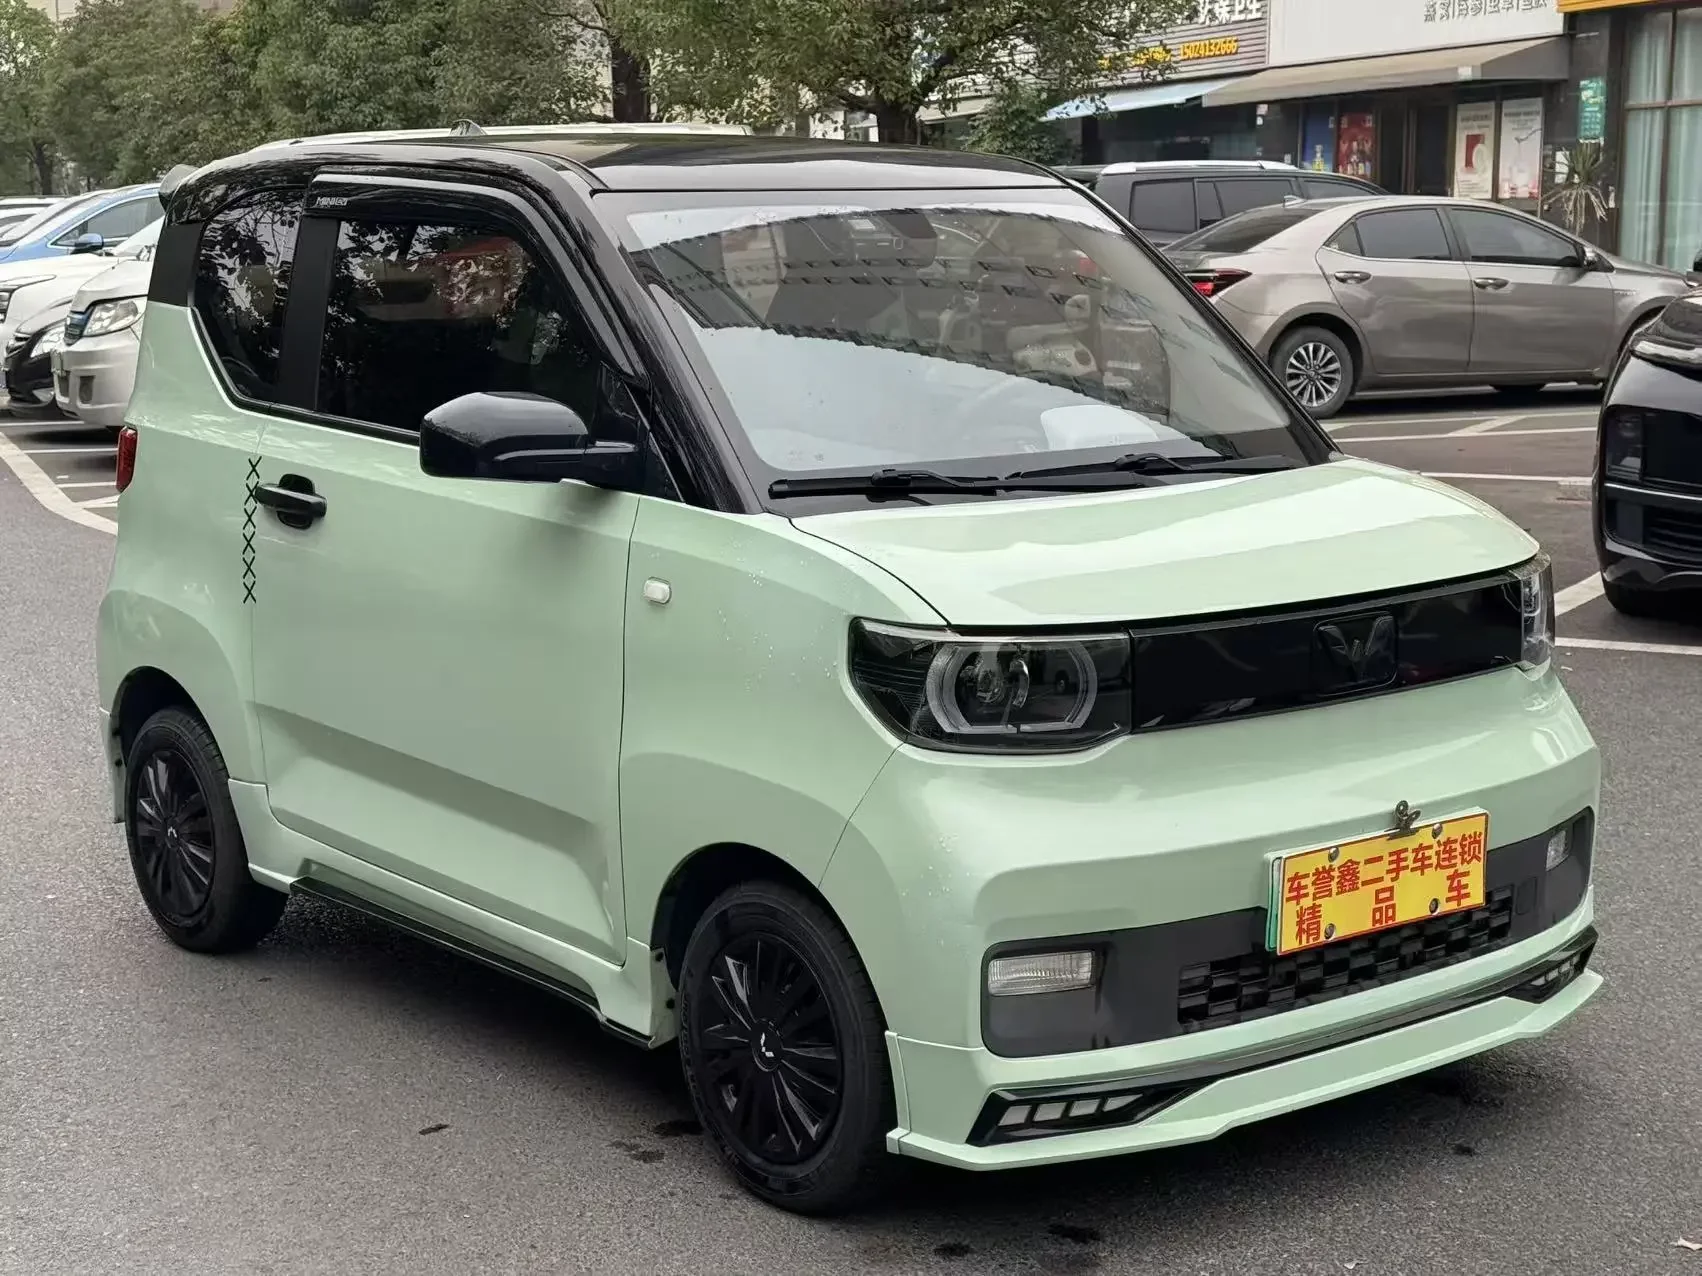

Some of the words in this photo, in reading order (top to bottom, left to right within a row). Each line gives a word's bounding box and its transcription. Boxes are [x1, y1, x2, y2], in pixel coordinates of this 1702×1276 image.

[1285, 831, 1483, 905] 车誉鑫二手车连锁
